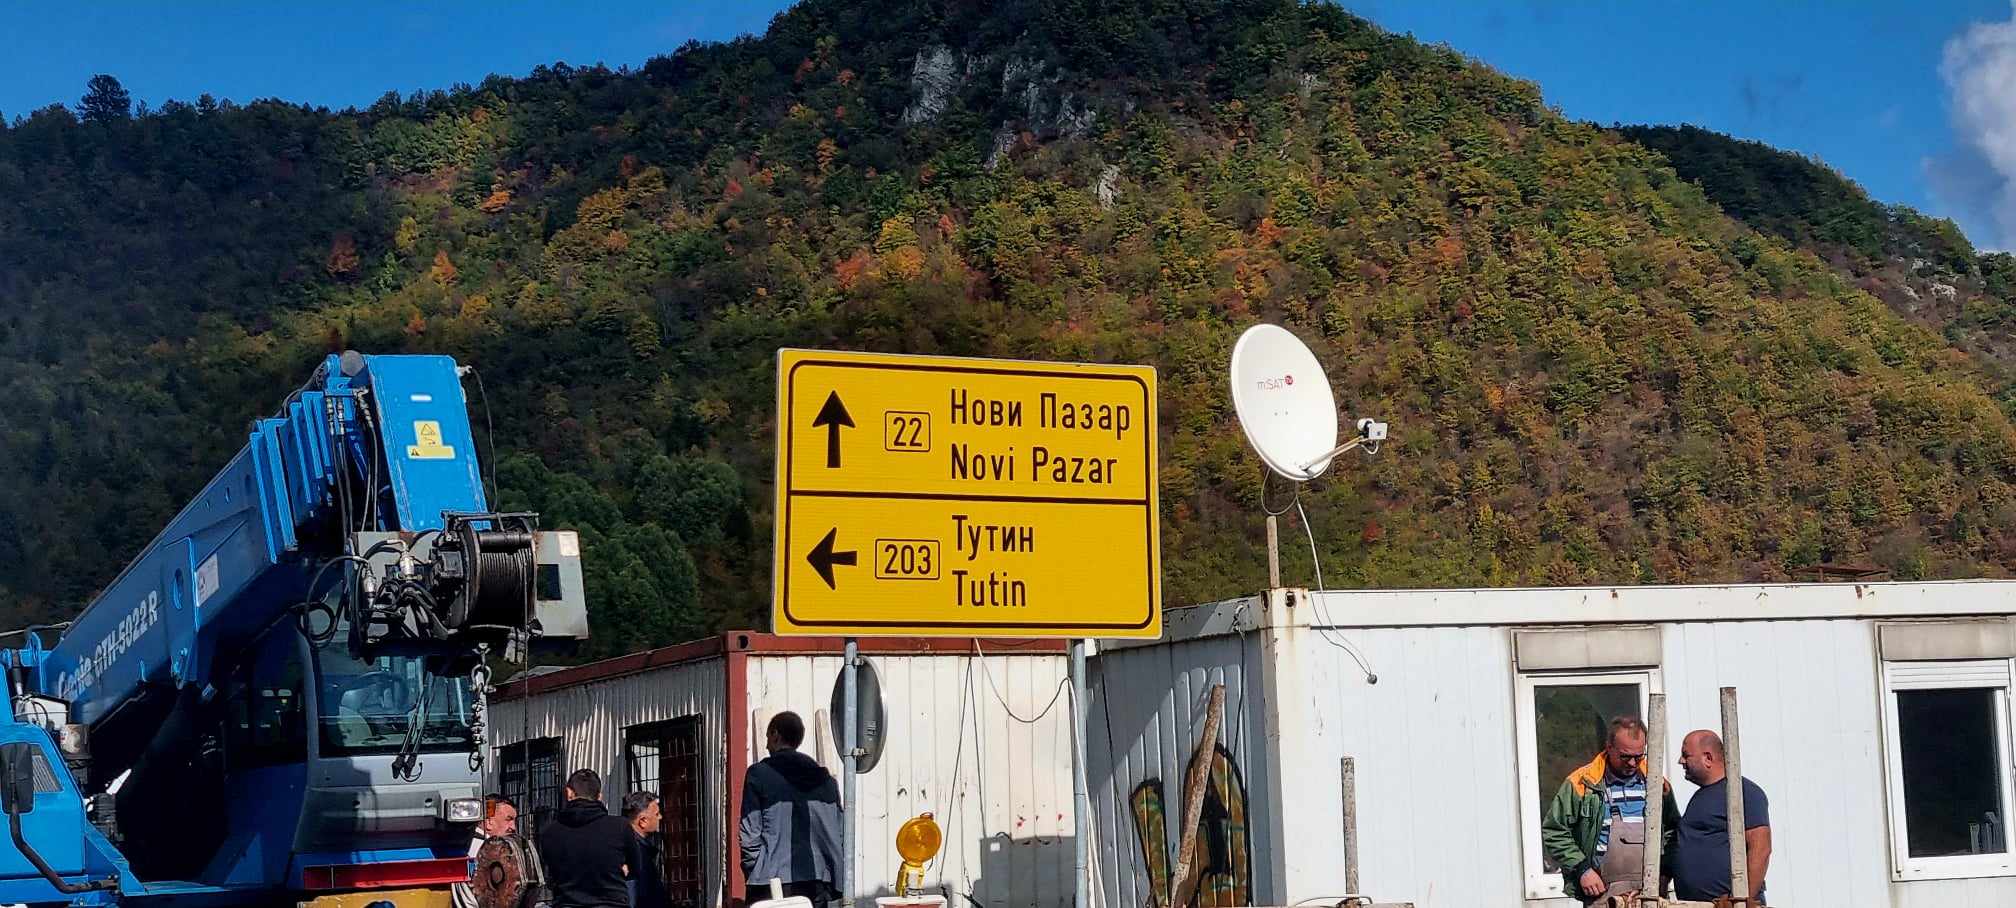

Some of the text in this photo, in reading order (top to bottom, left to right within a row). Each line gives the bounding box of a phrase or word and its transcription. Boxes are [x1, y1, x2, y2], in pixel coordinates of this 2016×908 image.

[893, 416, 922, 446] 22
[951, 388, 1130, 440] Нови Пазар
[951, 442, 1117, 484] Novi Pazar
[952, 514, 1034, 561] Тутин
[884, 543, 931, 574] 203
[952, 570, 1026, 607] Tutin
